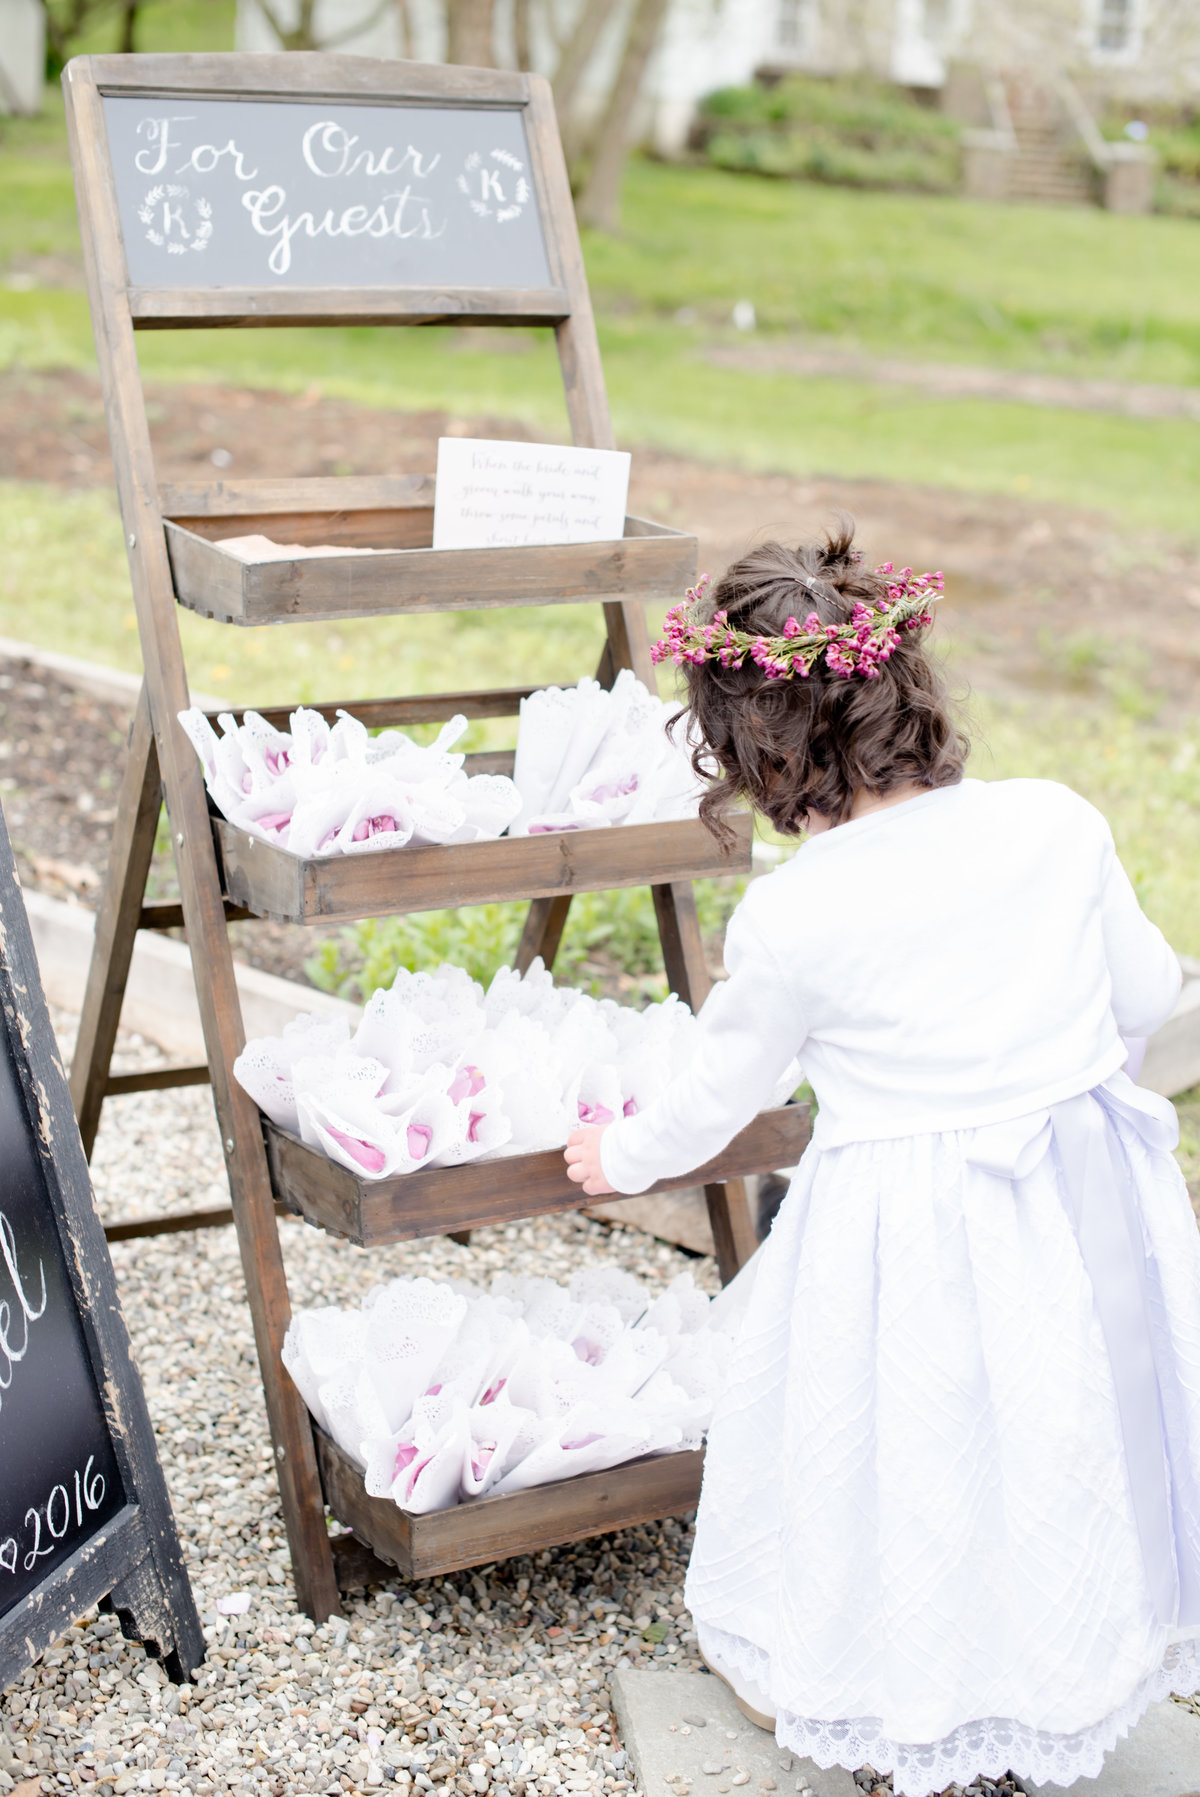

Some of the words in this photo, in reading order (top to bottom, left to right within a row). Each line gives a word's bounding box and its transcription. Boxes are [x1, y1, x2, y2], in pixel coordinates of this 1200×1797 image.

[135, 116, 259, 181] For
[302, 120, 441, 177] Our
[481, 168, 507, 203] K
[163, 202, 191, 239] K
[241, 184, 448, 275] Guests
[472, 450, 508, 470] When
[512, 460, 531, 472] the
[536, 460, 567, 476] bride
[573, 465, 601, 480] and
[460, 507, 492, 518] throw
[530, 510, 569, 530] petals
[574, 514, 602, 530] and
[23, 1454, 106, 1572] 2016
